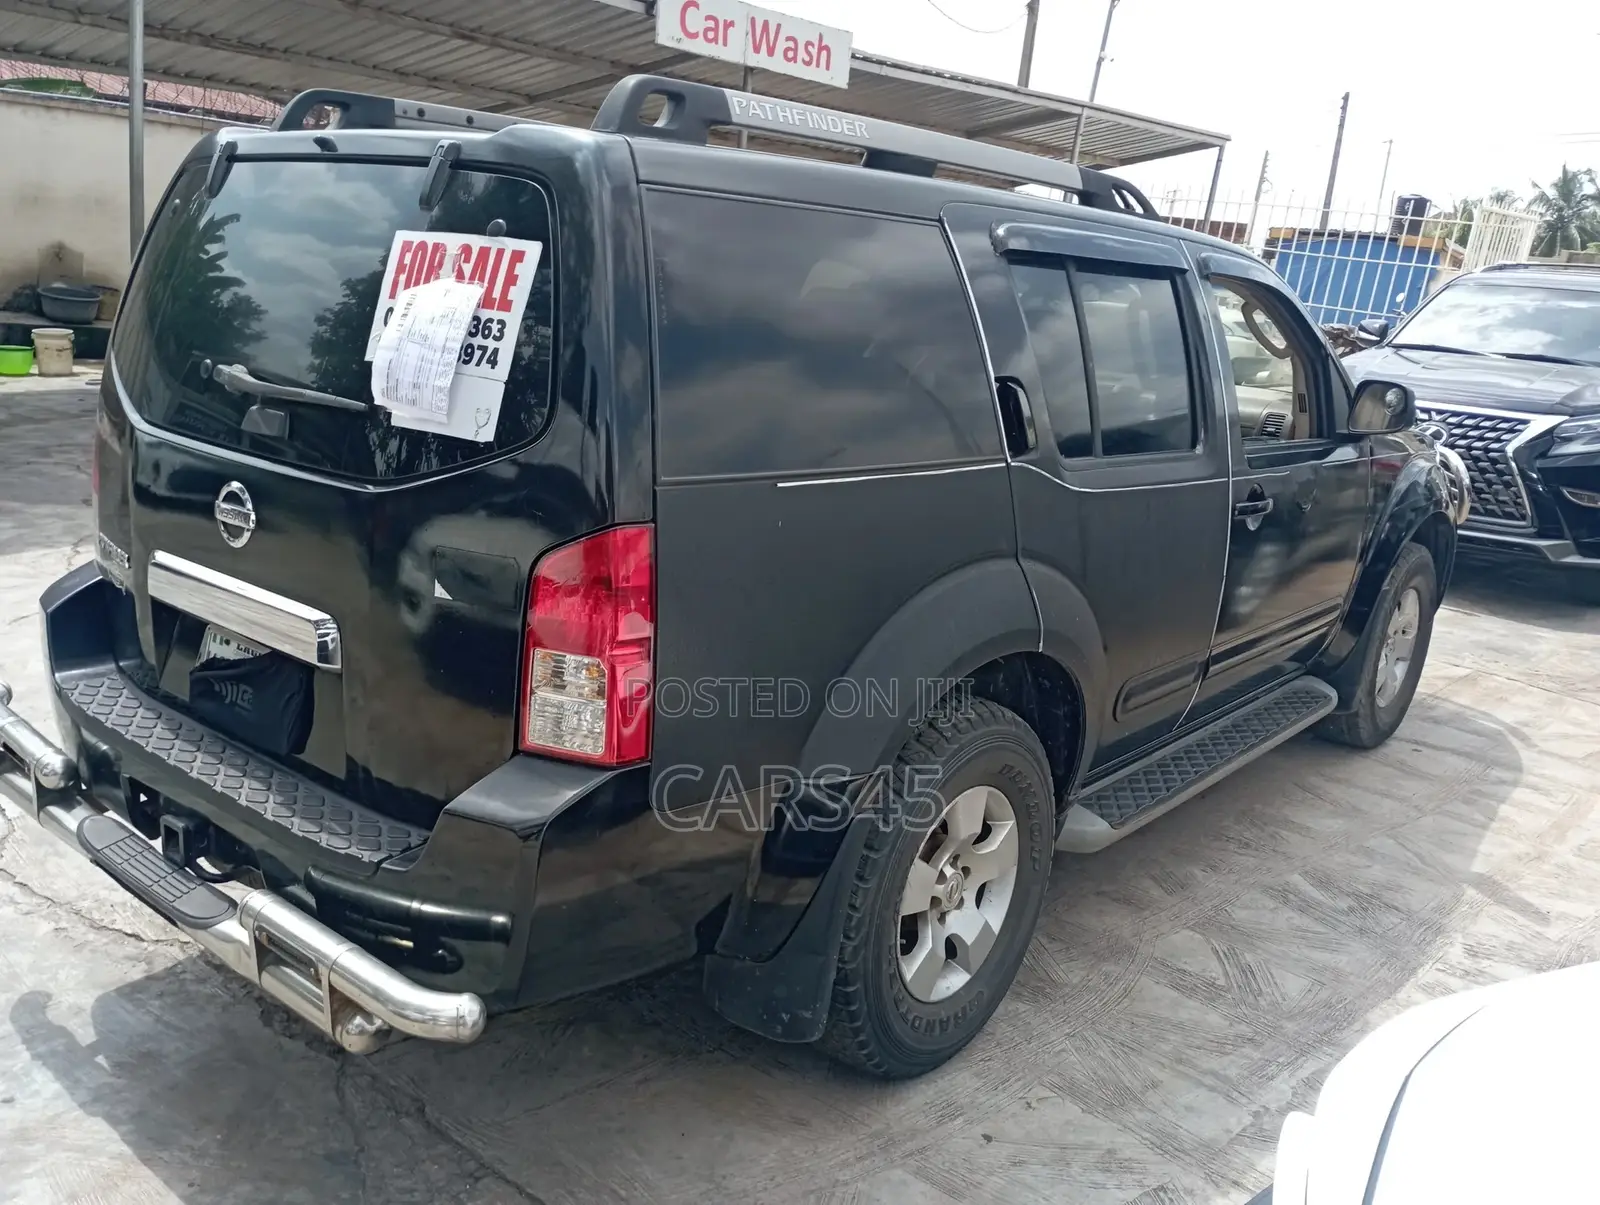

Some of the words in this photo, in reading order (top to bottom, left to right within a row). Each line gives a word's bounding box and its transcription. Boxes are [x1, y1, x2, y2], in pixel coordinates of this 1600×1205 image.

[679, 0, 735, 47] Car
[750, 16, 832, 71] Wash
[731, 96, 870, 139] PATHFINDER
[388, 240, 446, 300] FOR
